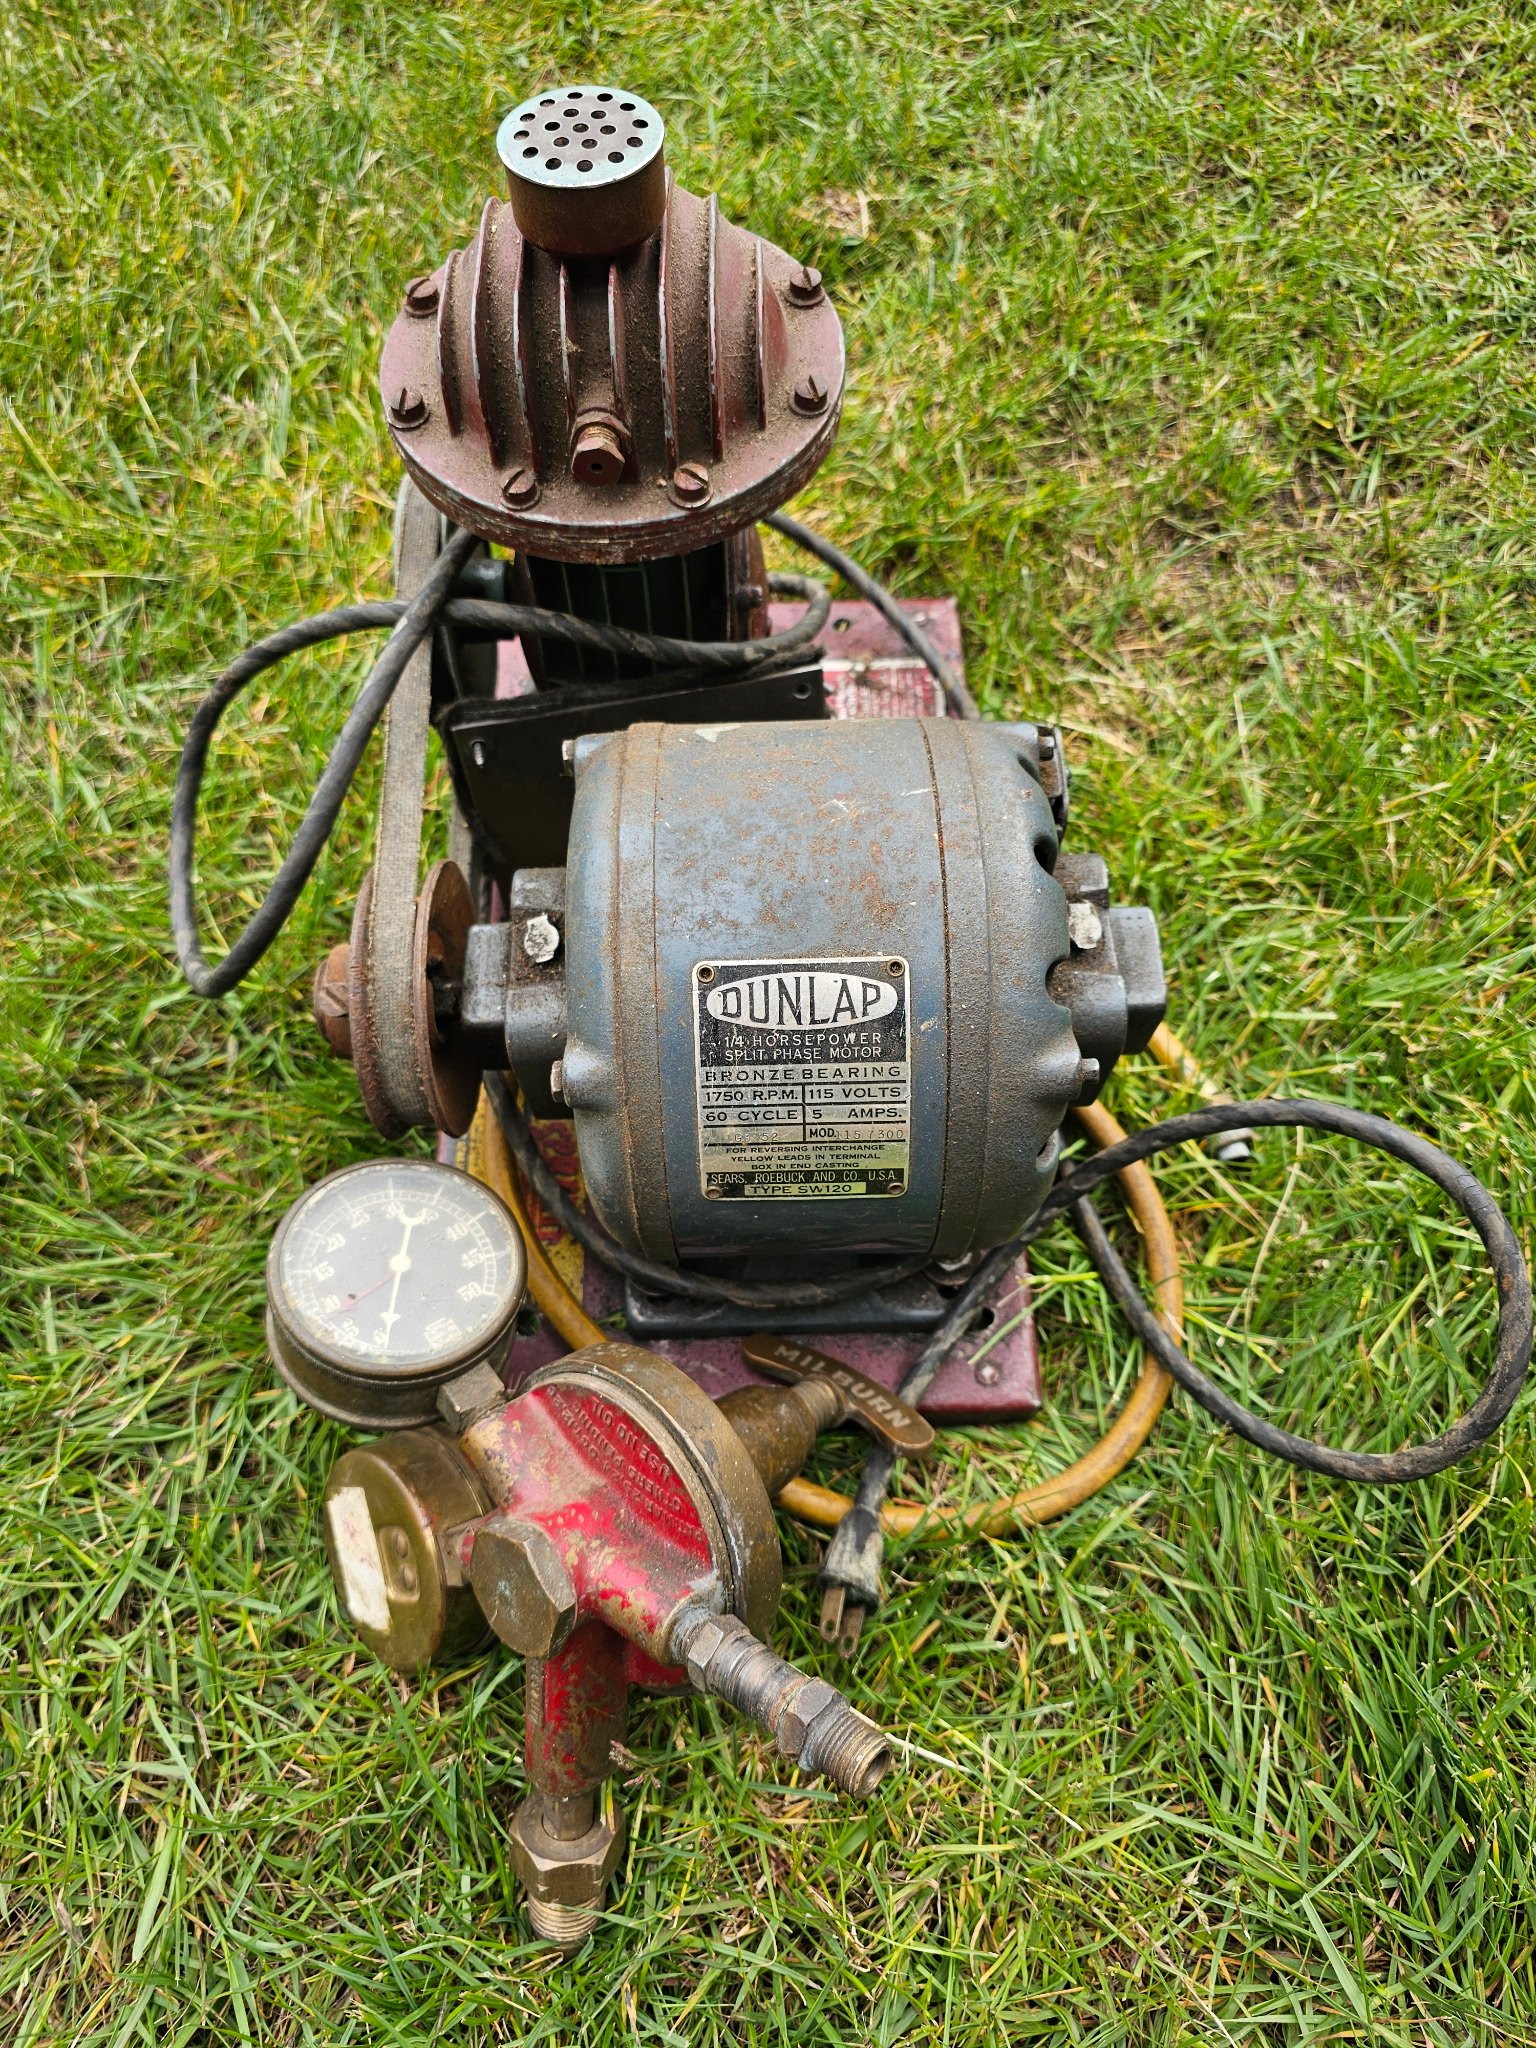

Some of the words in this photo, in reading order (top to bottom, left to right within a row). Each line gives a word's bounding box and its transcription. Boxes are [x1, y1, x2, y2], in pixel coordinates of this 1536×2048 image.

[718, 976, 881, 1026] DUNLAP
[725, 1035, 744, 1048] 1/4
[753, 1032, 881, 1047] HORSEPOWER
[725, 1049, 765, 1061] SPLIT
[774, 1047, 821, 1060] PHASE
[830, 1046, 881, 1059] MOTOR
[705, 1069, 795, 1082] BRONZE
[802, 1066, 901, 1080] BEARING
[706, 1091, 744, 1102] 1750
[753, 1089, 798, 1101] R.P.M.
[809, 1088, 834, 1099] 115
[842, 1087, 901, 1099] VOLTS
[705, 1112, 727, 1122] 60
[738, 1109, 798, 1121] CYCLE
[812, 1109, 822, 1119] 5
[847, 1107, 902, 1118] AMPS.
[757, 1172, 805, 1183] ROEBUCK
[812, 1171, 836, 1182] AND
[843, 1171, 861, 1181] CO.
[751, 1186, 792, 1194] TYPE
[798, 1185, 852, 1193] SW120
[462, 1247, 484, 1269] 45
[457, 1281, 482, 1302] 50
[774, 1345, 911, 1428] MILBURN
[639, 1444, 672, 1482] USE
